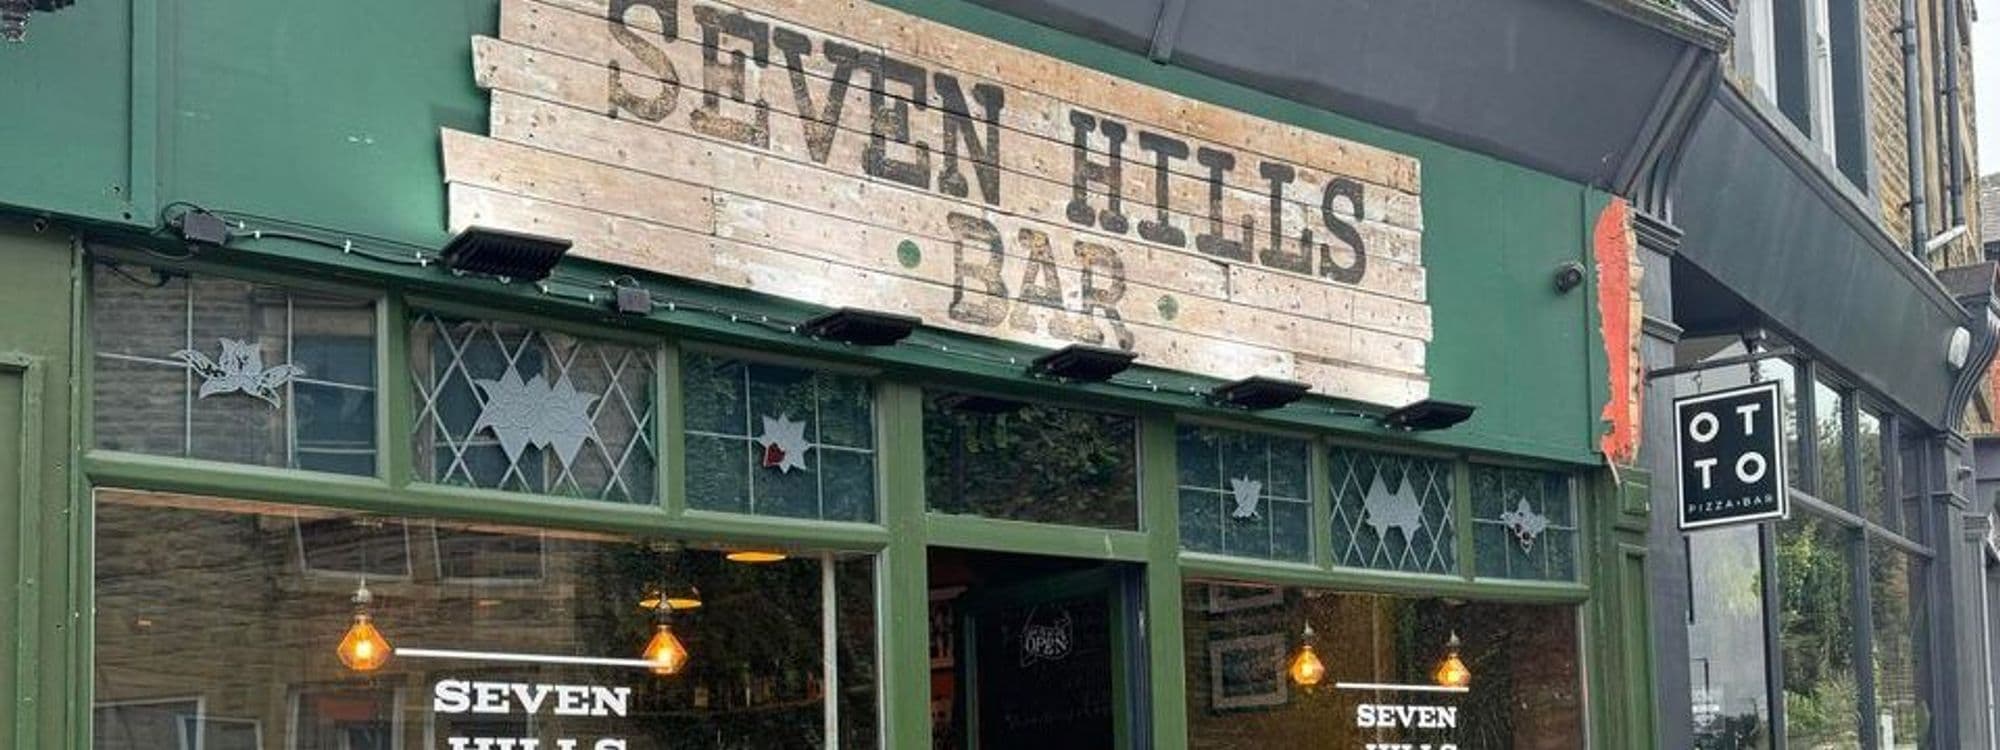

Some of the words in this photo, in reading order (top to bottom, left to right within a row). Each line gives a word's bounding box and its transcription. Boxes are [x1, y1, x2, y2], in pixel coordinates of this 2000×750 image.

[608, 0, 1005, 206] SEVEN
[1065, 109, 1367, 286] HILLS
[946, 211, 1135, 352] BAR
[434, 679, 632, 717] SEVEN
[1357, 703, 1458, 729] SEVEN
